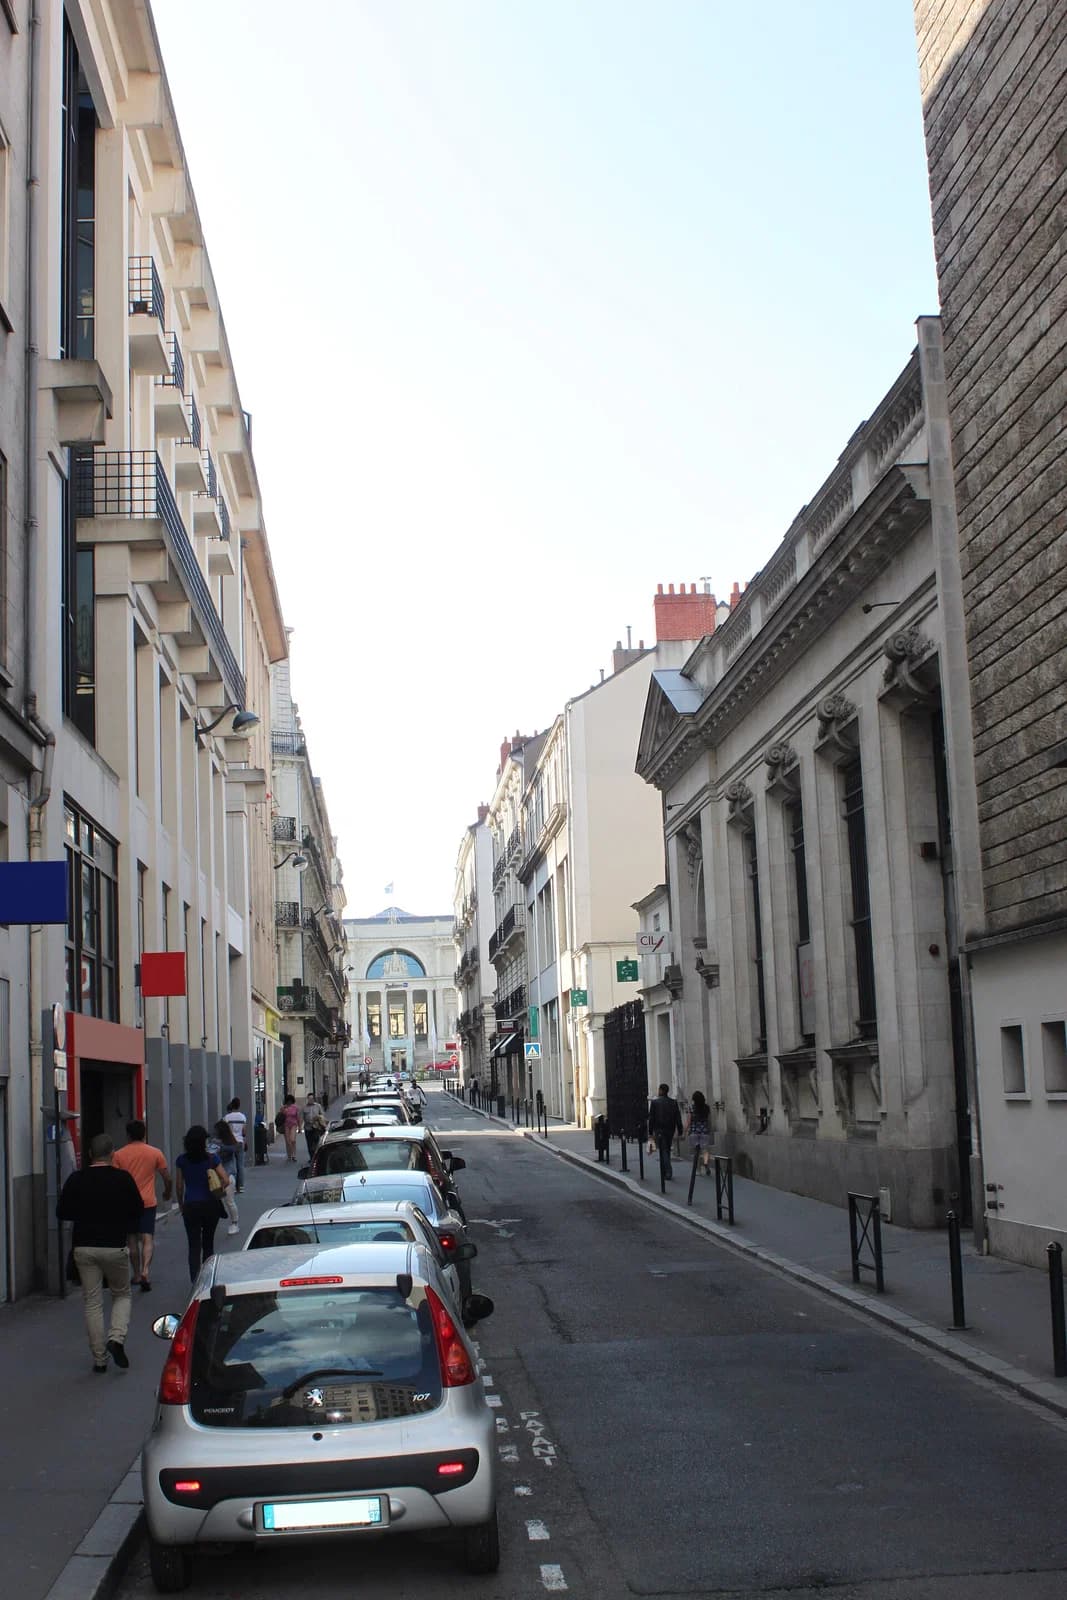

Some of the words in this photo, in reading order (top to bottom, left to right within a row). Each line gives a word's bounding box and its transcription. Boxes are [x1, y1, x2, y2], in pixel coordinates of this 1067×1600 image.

[640, 935, 659, 947] CIL
[412, 1393, 431, 1402] 107
[520, 1411, 557, 1466] PAYANT
